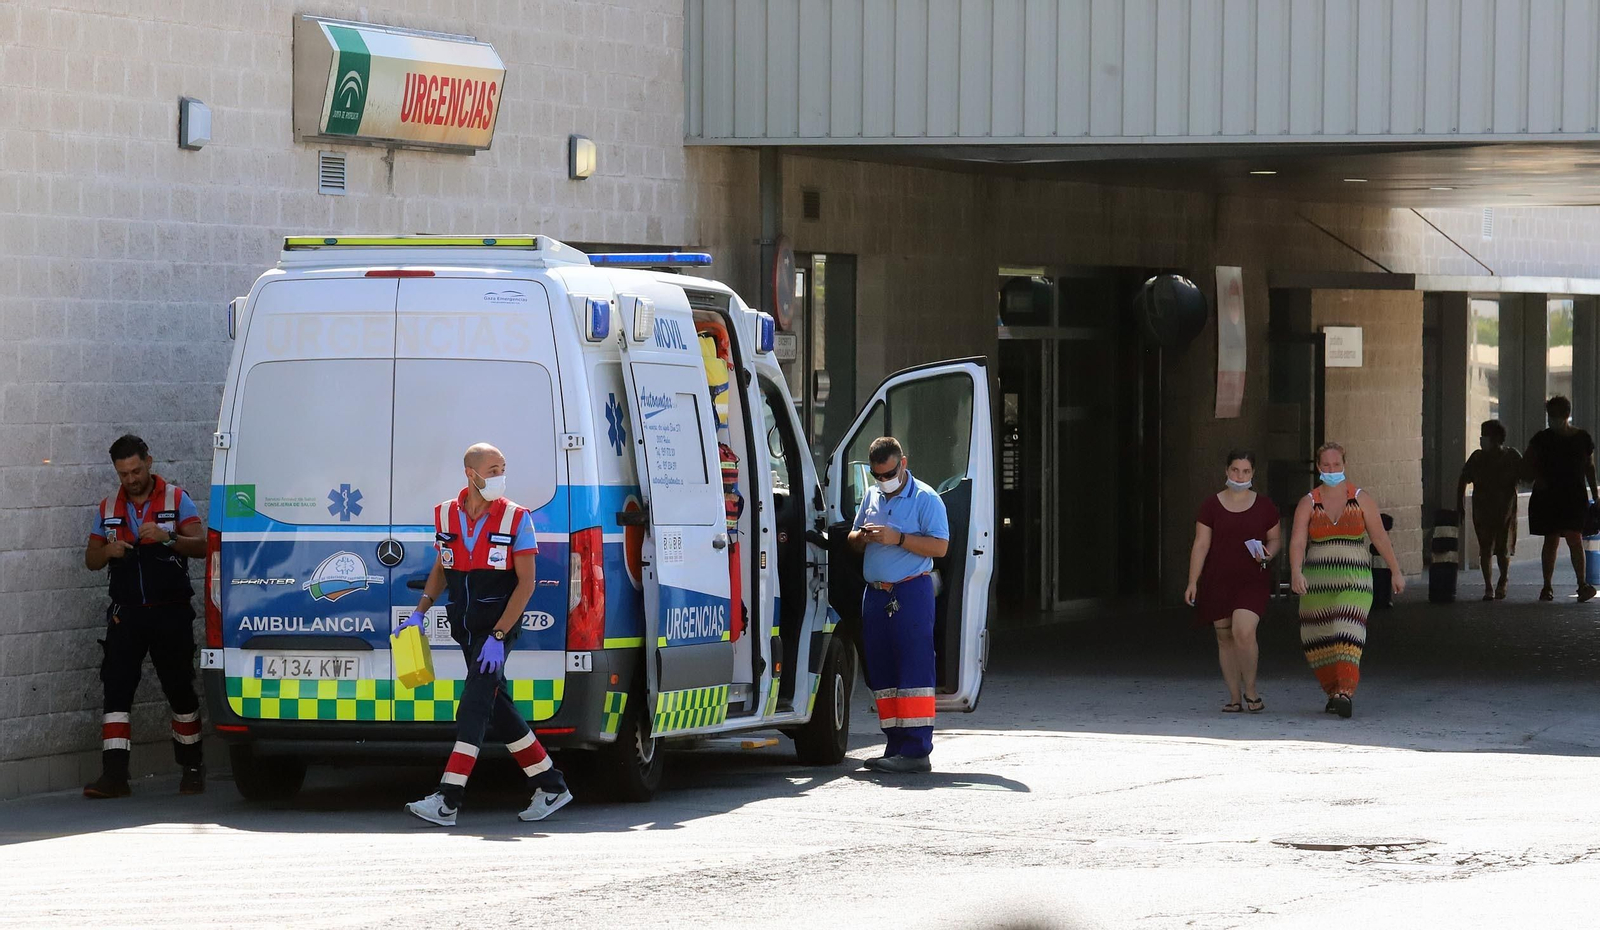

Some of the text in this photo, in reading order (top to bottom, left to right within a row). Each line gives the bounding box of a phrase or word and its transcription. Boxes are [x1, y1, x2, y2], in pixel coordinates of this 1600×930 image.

[401, 72, 497, 130] URGENCIAS
[265, 315, 531, 356] URGENCIAS
[238, 615, 376, 633] AMBULANCIA
[666, 604, 726, 641] URGENCIAS
[266, 659, 355, 678] 4134 KWF
